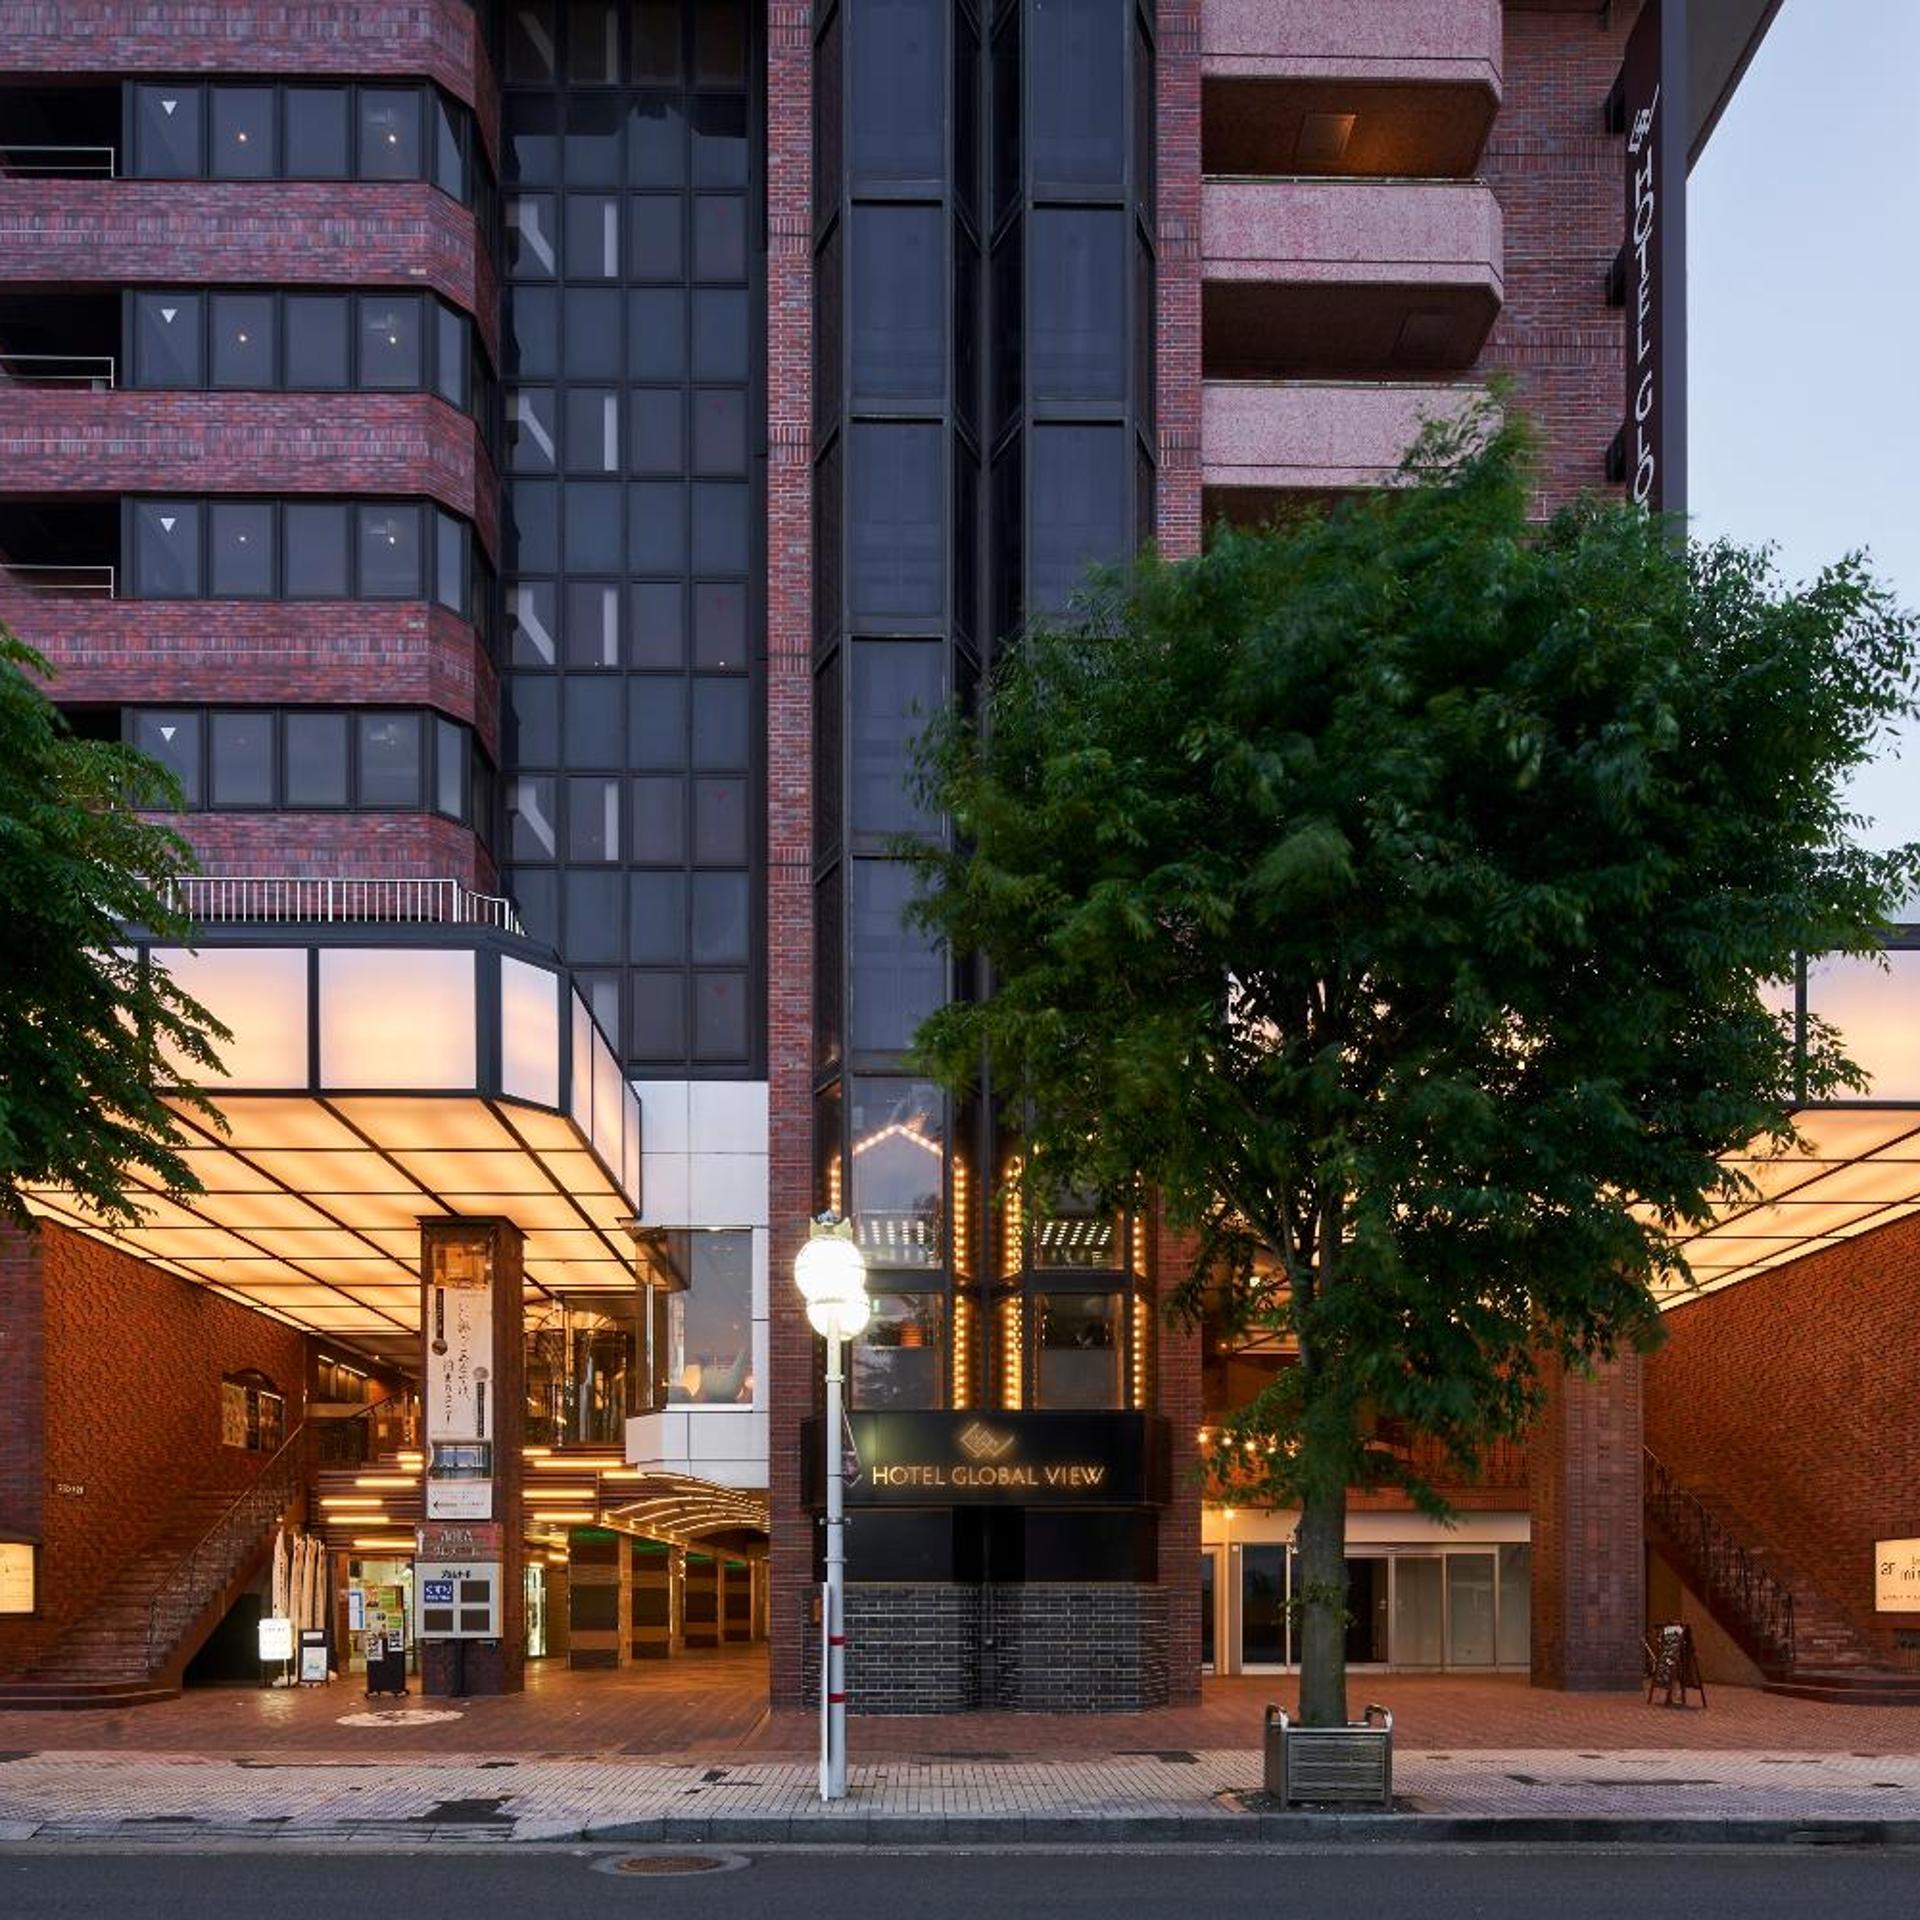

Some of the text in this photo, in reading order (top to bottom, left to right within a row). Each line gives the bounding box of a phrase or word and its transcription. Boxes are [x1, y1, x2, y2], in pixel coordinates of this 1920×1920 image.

[1633, 146, 1654, 366] HOTEL
[872, 1465, 1106, 1485] HOTEL GLOBAL VIEW
